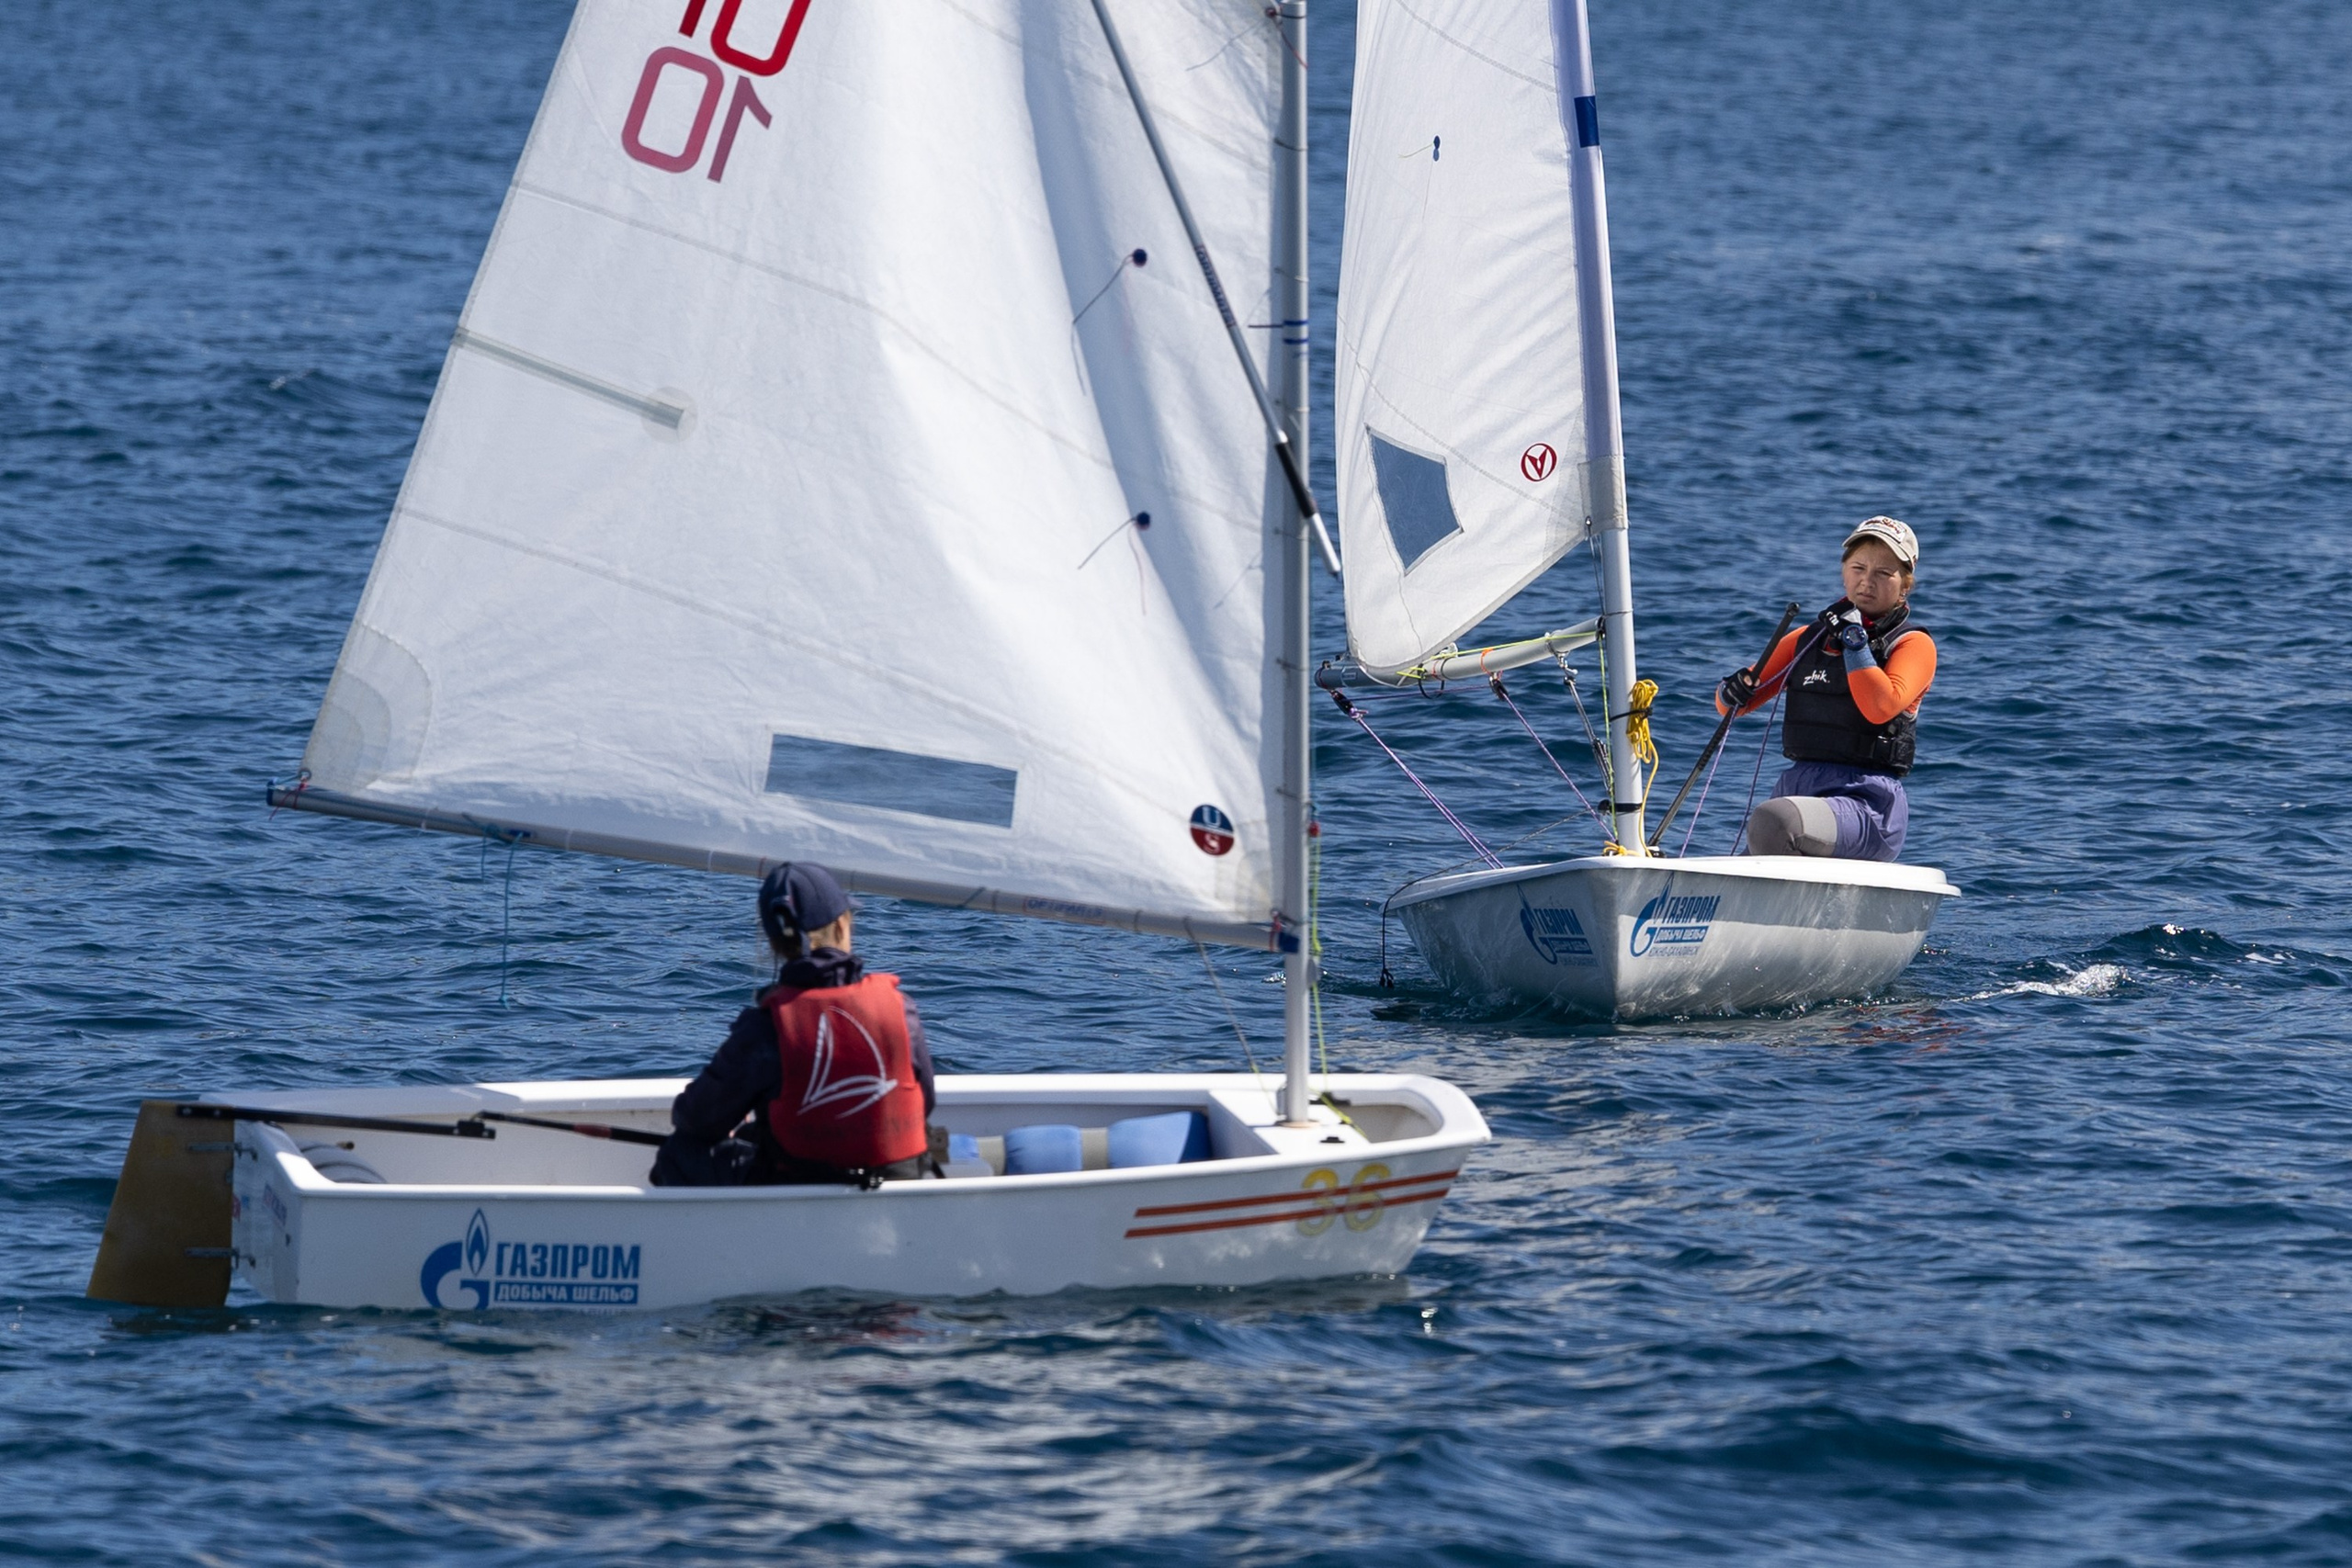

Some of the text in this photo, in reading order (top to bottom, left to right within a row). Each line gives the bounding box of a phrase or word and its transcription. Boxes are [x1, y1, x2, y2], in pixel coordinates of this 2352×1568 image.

[1803, 670, 1827, 686] zhik
[1662, 895, 1722, 924] ГАЗПРОМ
[1295, 1162, 1392, 1238] 36
[494, 1242, 641, 1280] ГАЗПРОМ
[497, 1283, 635, 1303] ДОБЫЧА ШЕЛЬФ
